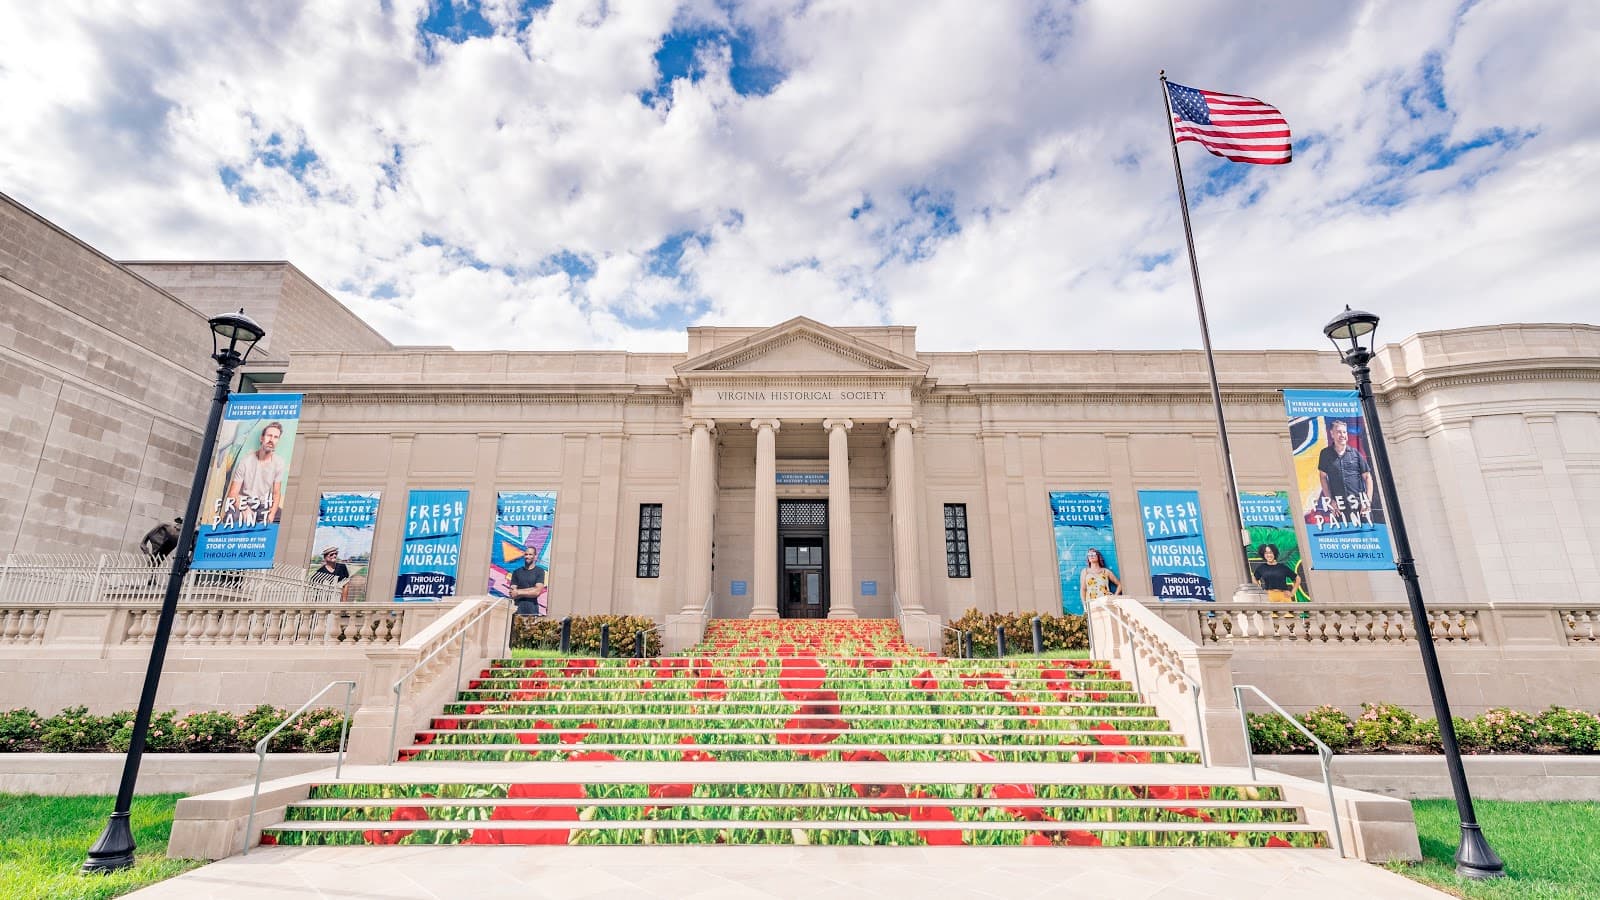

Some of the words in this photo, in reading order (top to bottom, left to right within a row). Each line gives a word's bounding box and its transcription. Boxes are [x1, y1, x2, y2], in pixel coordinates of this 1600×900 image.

[717, 392, 766, 400] VIRGINIA
[771, 392, 832, 400] HISTORICAL
[840, 392, 886, 400] SOCIETY
[214, 492, 273, 512] FRESH
[410, 501, 463, 519] FRESH
[1144, 502, 1197, 520] FRESH
[1312, 492, 1371, 512] FRESH
[212, 510, 270, 531] PAINT
[409, 517, 462, 535] PAINT
[1147, 518, 1198, 536] PAINT
[1314, 511, 1374, 530] PAINT
[406, 544, 458, 553] VIRGINIA
[1150, 545, 1204, 554] VIRGINIA
[403, 555, 457, 565] MURALS
[1152, 556, 1206, 567] MURALS
[403, 584, 434, 594] APRIL
[1161, 586, 1192, 595] APRIL
[1195, 586, 1207, 595] 21
